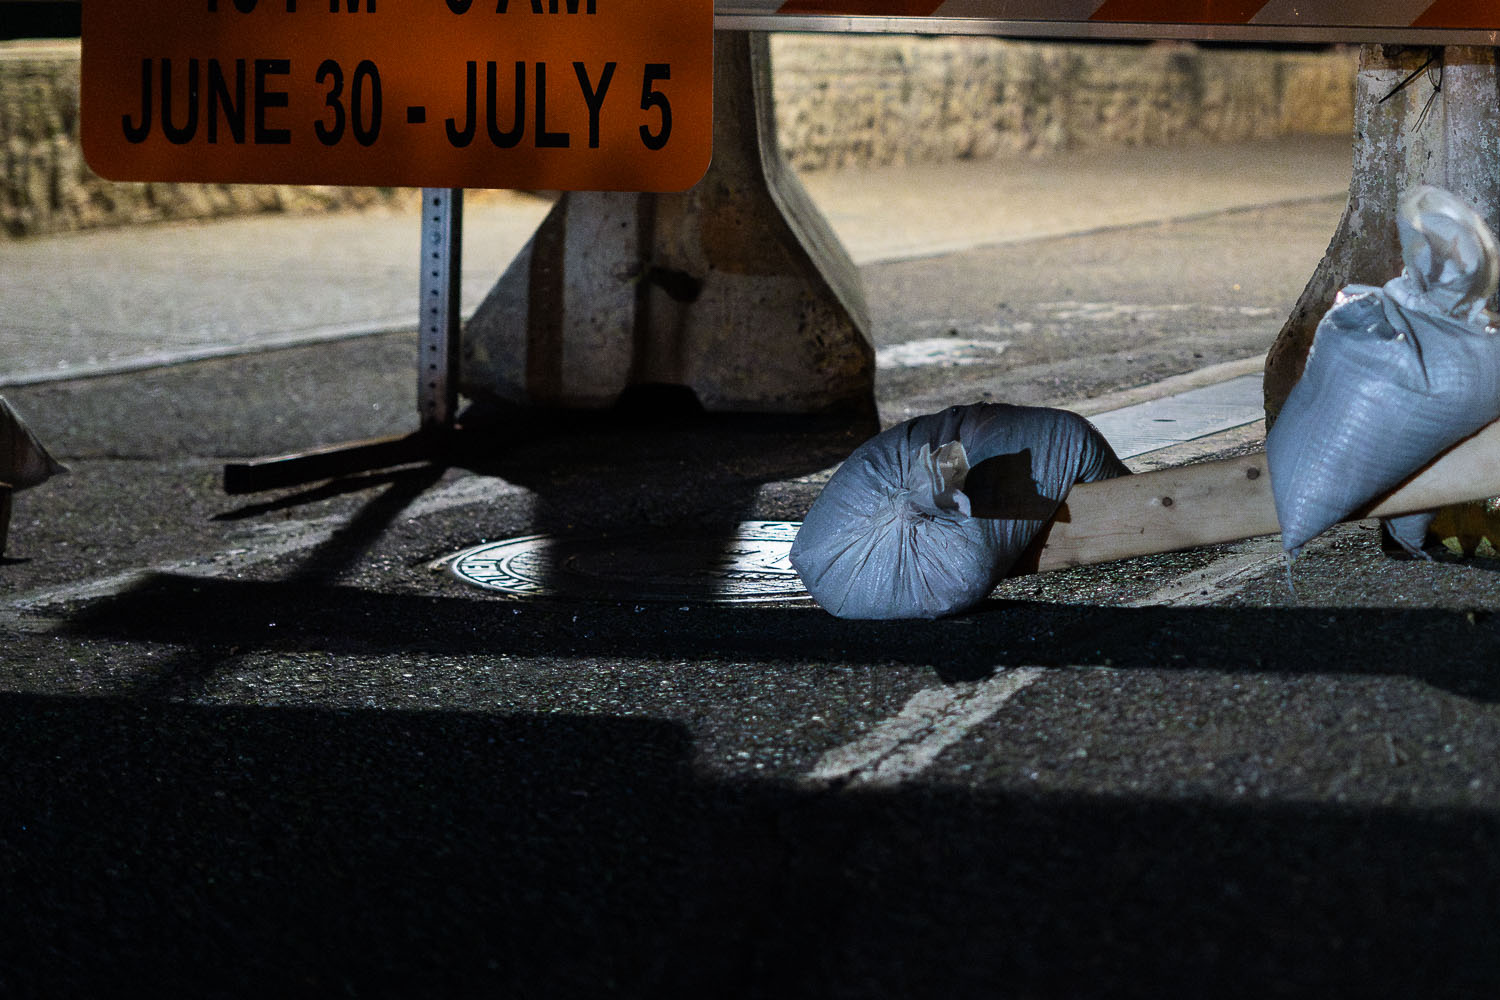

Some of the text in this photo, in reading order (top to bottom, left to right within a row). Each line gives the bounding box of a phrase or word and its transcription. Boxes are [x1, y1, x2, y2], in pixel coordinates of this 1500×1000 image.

[121, 59, 673, 150] JUNE 30 - JULY 5
